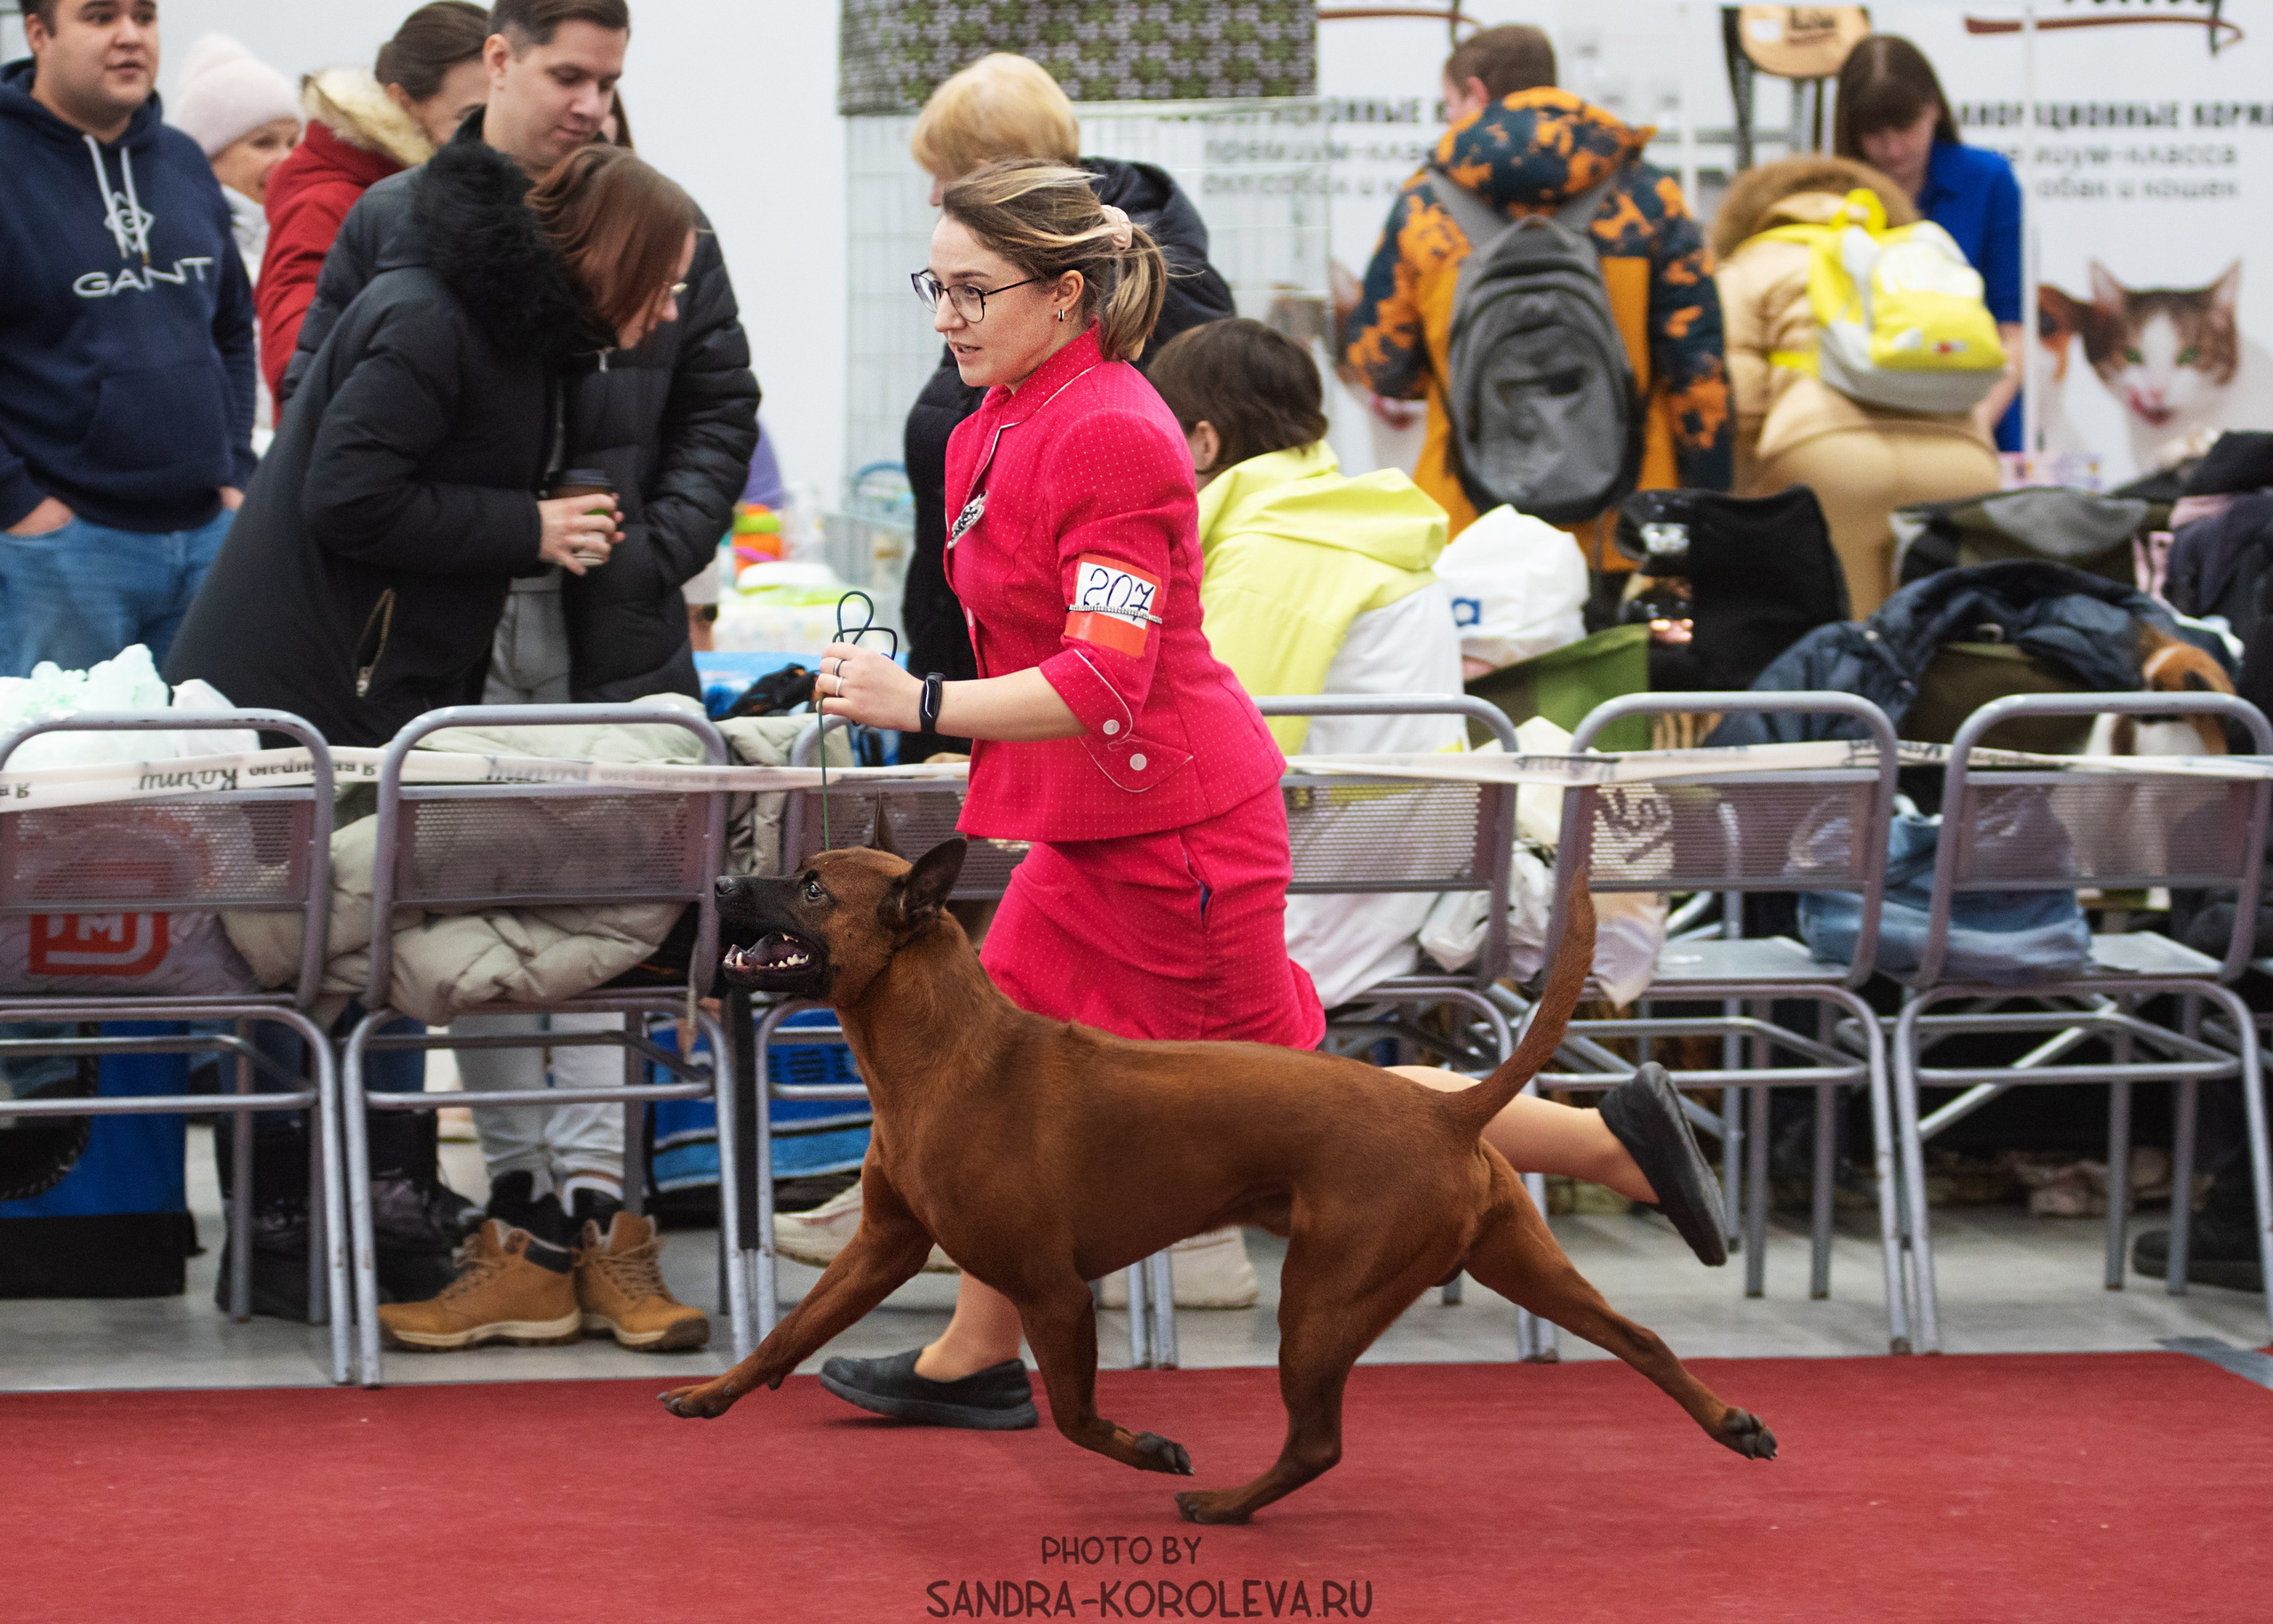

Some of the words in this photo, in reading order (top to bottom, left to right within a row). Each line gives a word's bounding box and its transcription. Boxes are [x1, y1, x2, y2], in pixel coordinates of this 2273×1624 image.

[2192, 102, 2273, 128] КОРМ
[72, 257, 213, 298] GANT
[1083, 567, 1155, 622] 207
